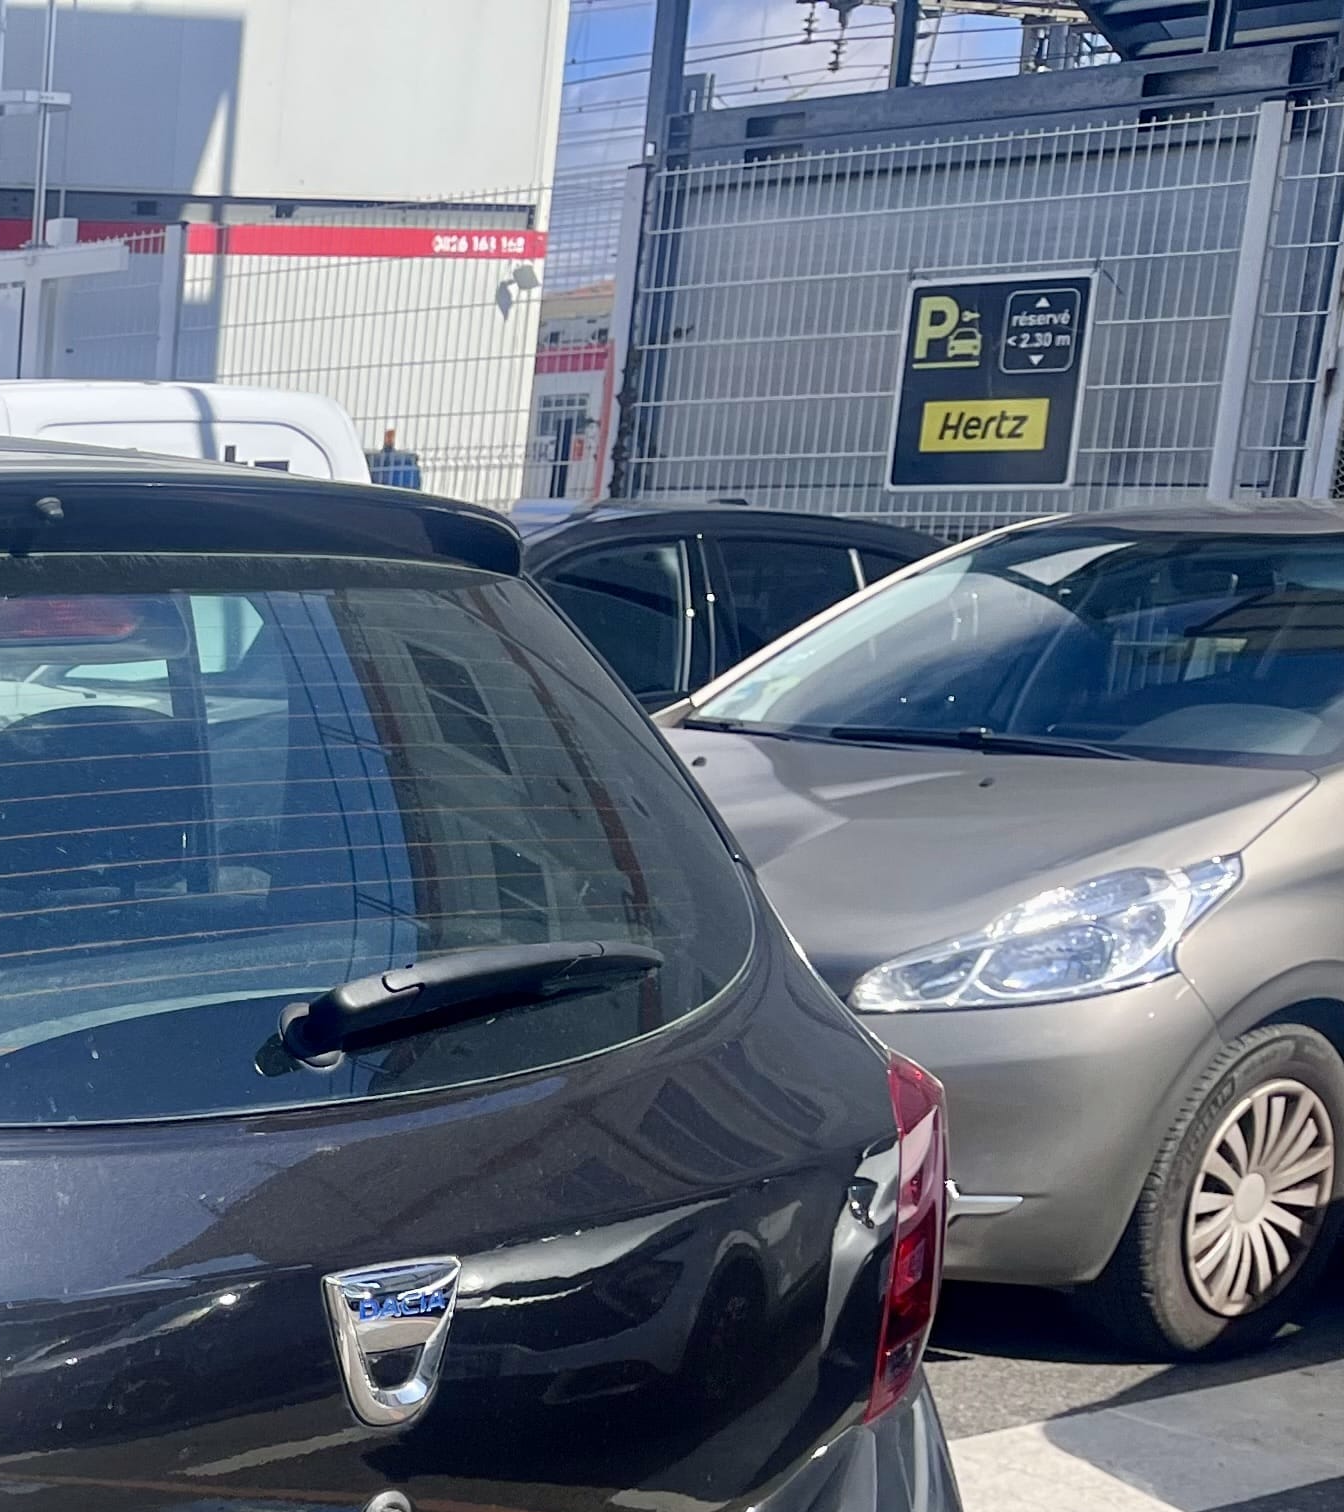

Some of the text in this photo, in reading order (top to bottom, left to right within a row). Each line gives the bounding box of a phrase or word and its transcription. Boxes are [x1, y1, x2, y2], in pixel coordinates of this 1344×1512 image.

[1012, 309, 1071, 327] réservé
[1019, 332, 1052, 349] 2.30
[1055, 334, 1071, 346] m
[938, 410, 1029, 440] Hertz
[359, 1289, 446, 1321] DACIA
